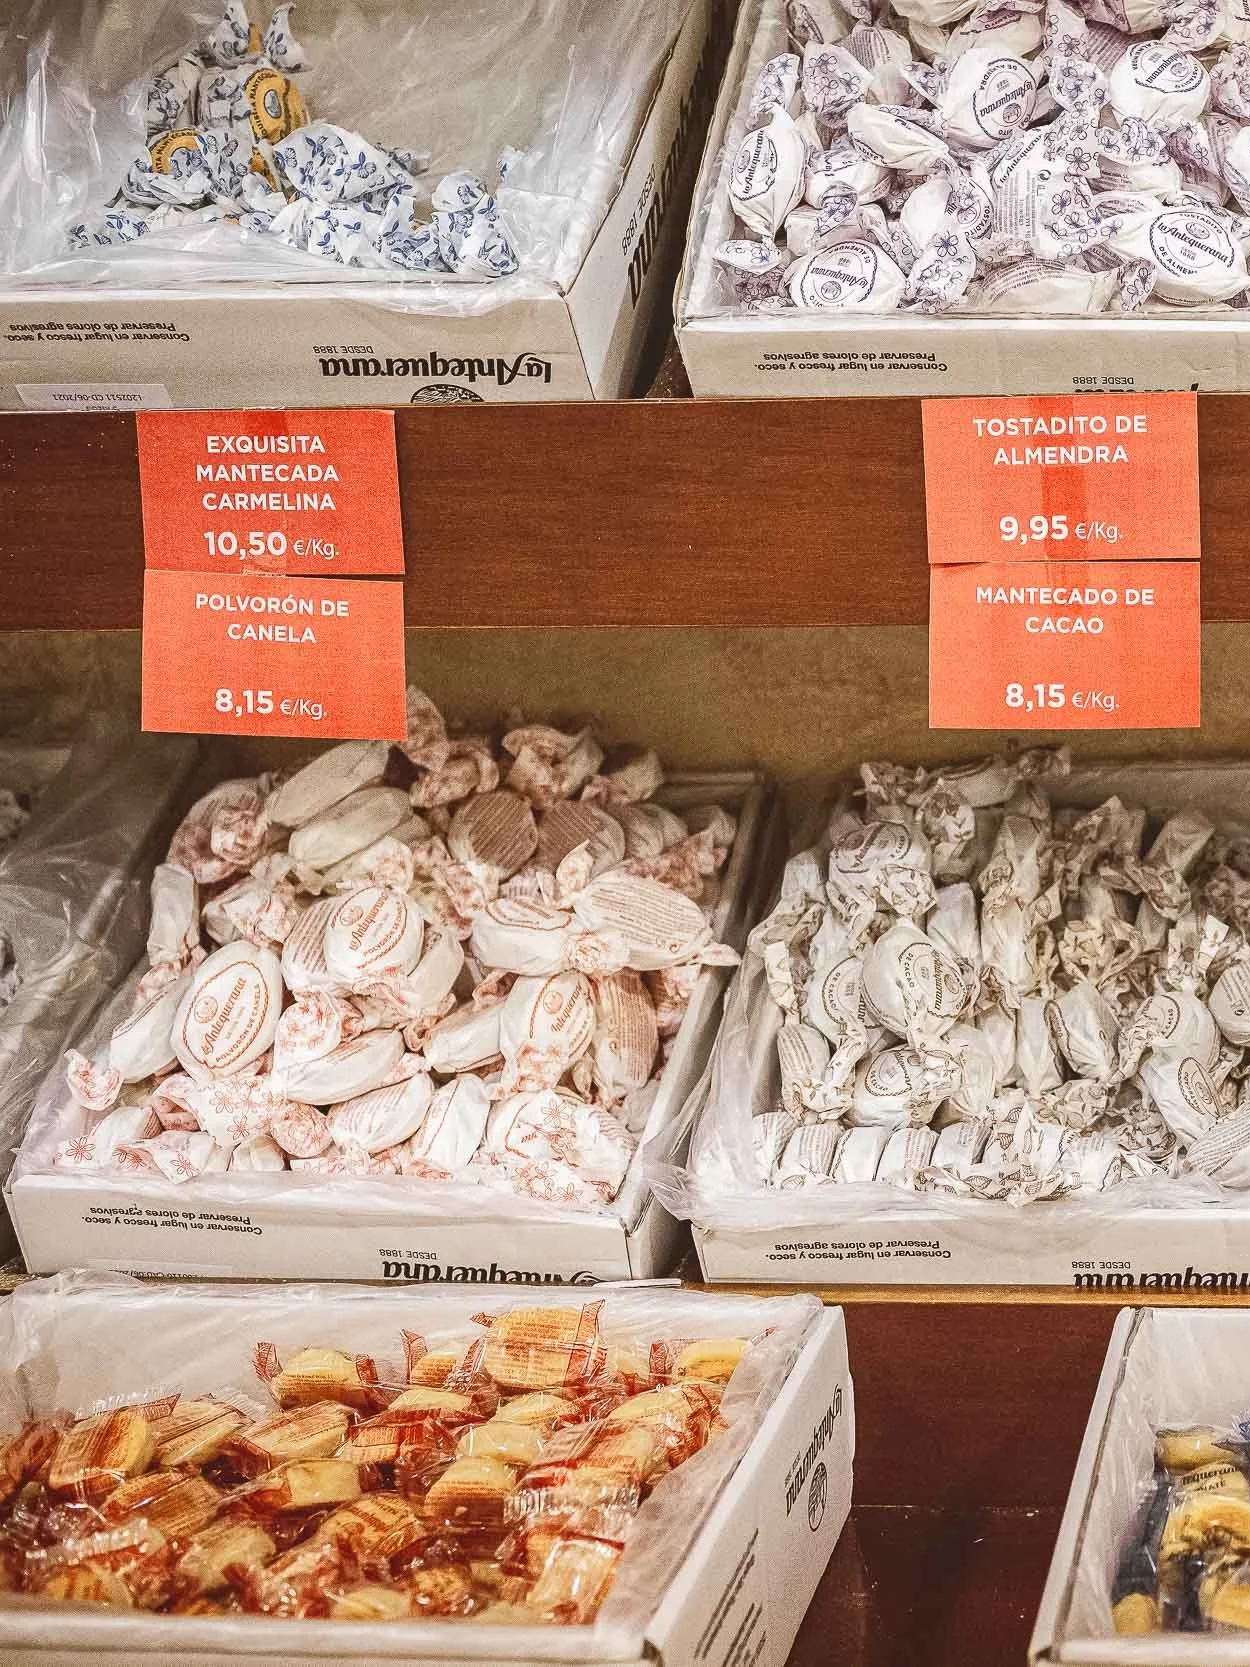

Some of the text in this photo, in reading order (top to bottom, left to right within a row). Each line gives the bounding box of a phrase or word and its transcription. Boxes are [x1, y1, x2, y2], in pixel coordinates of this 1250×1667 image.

[10, 322, 177, 332] Preservar de olores agresivos
[3, 333, 35, 341] seco.
[46, 333, 82, 342] fresco
[84, 333, 114, 342] lugar
[115, 333, 129, 341] en
[132, 333, 190, 342] Conservar
[313, 345, 374, 354] DESDE 1888
[763, 352, 936, 361] Preservar de olores agresivos
[319, 351, 536, 386] Antequerana
[754, 363, 786, 371] seco.
[799, 362, 836, 371] fresco
[838, 362, 868, 371] lugar
[888, 362, 948, 372] Conservar
[1072, 376, 1134, 385] DESDE 1888
[972, 415, 1148, 437] TOSTADITO DE
[206, 435, 326, 454] EXQUISITA
[993, 445, 1129, 465] ALMENDRA
[195, 464, 340, 482] MANTECADA
[202, 492, 337, 511] CARMELINA
[999, 515, 1123, 545] 9,95 €/Kg.
[203, 531, 340, 560] 10,50 €/Kg.
[975, 587, 1154, 605] MANTECADO DE
[195, 593, 350, 617] POLVORÓN DE
[1025, 616, 1104, 634] CACAO
[227, 623, 317, 644] CANELA
[1005, 683, 1120, 712] 8,15 €/Kg.
[215, 688, 328, 720] 8,15 €/Kg.
[82, 1216, 112, 1225] seco.
[90, 1207, 251, 1225] Preservar de olores agresivos
[123, 1217, 158, 1228] fresco
[160, 1220, 188, 1231] lugar
[191, 1222, 204, 1230] en
[206, 1224, 263, 1235] Conservar
[775, 1240, 940, 1251] Preservar de olores agresivos
[379, 1248, 437, 1260] DESDE 1888
[766, 1252, 796, 1261] seco.
[808, 1251, 843, 1260] fresco
[845, 1251, 874, 1260] lugar
[894, 1250, 951, 1259] Conservar
[1072, 1261, 1131, 1269] DESDE 1888
